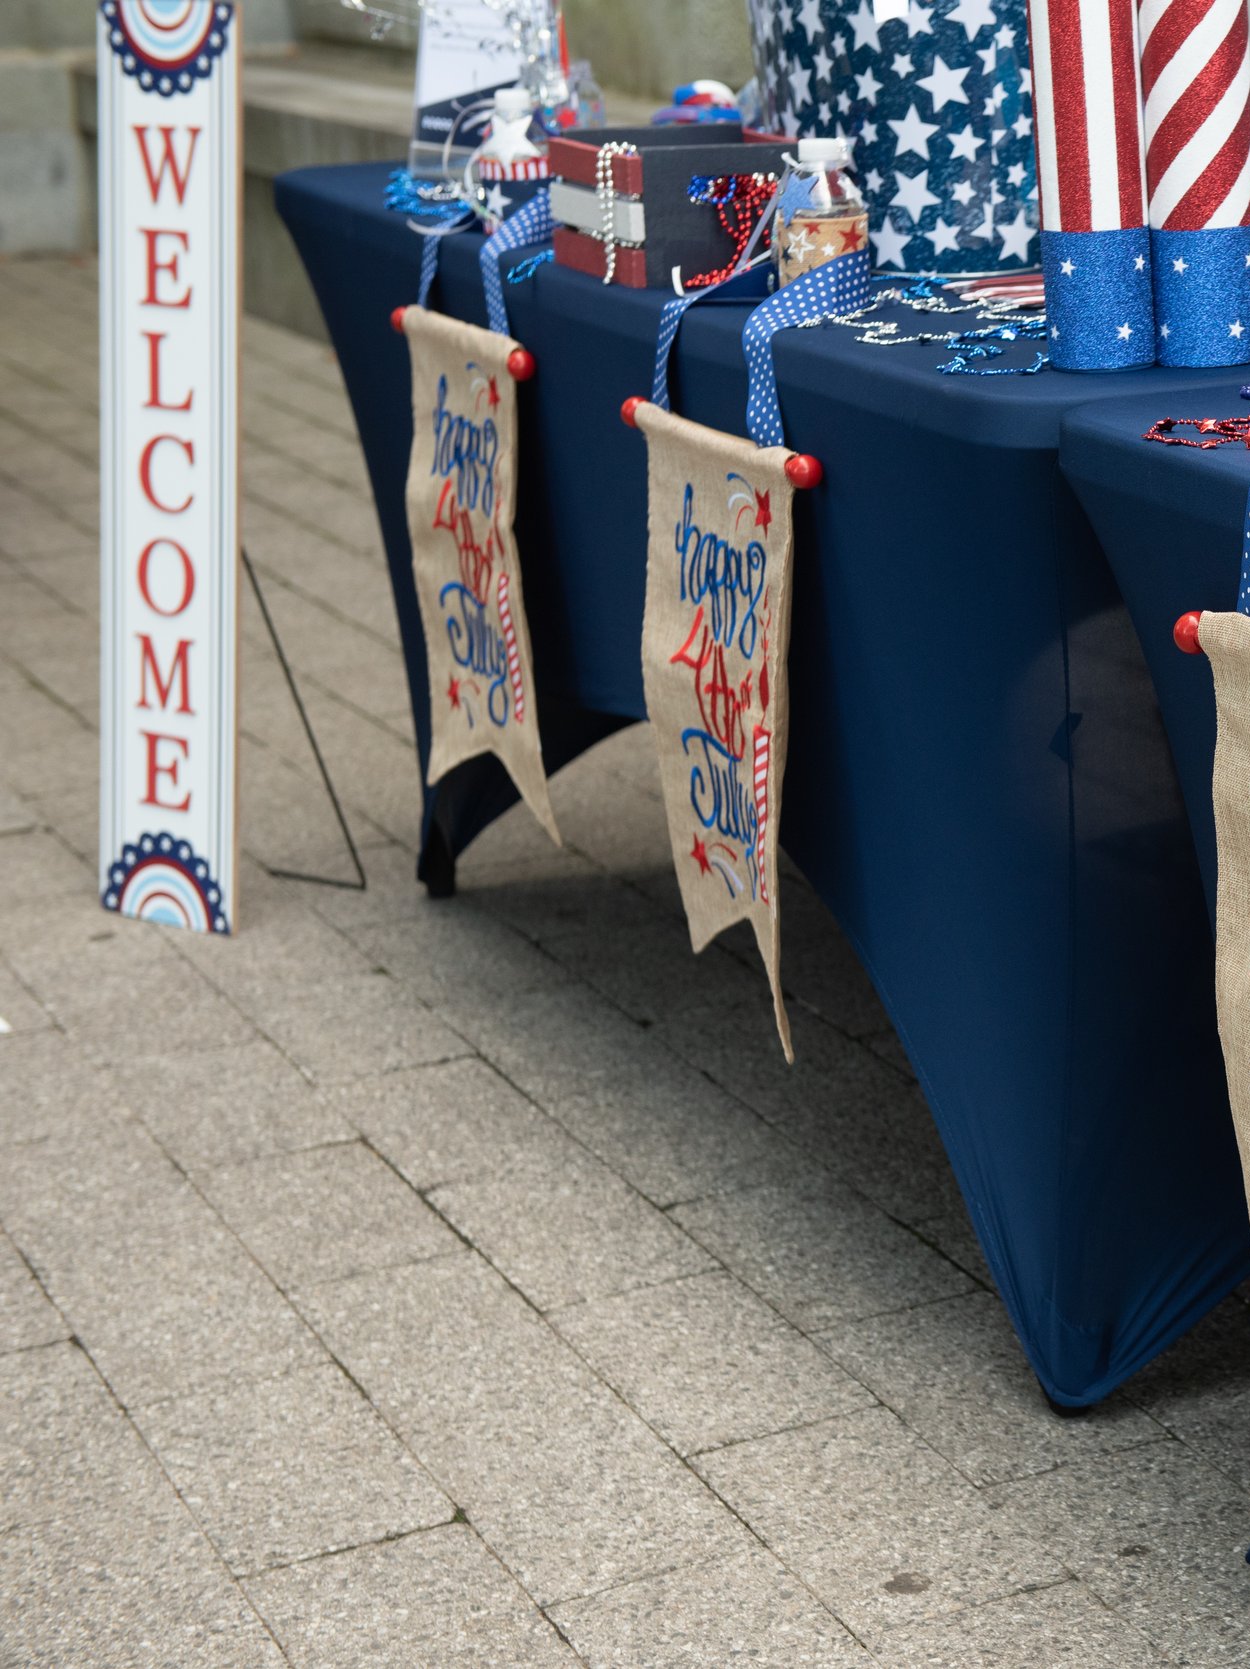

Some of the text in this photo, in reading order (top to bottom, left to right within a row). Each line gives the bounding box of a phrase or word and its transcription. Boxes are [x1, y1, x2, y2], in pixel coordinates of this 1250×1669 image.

[131, 124, 201, 813] WELCOME
[431, 373, 498, 518] happy
[675, 483, 767, 660] happy
[439, 581, 509, 728] July
[669, 605, 746, 760] 4th
[681, 728, 759, 901] July
